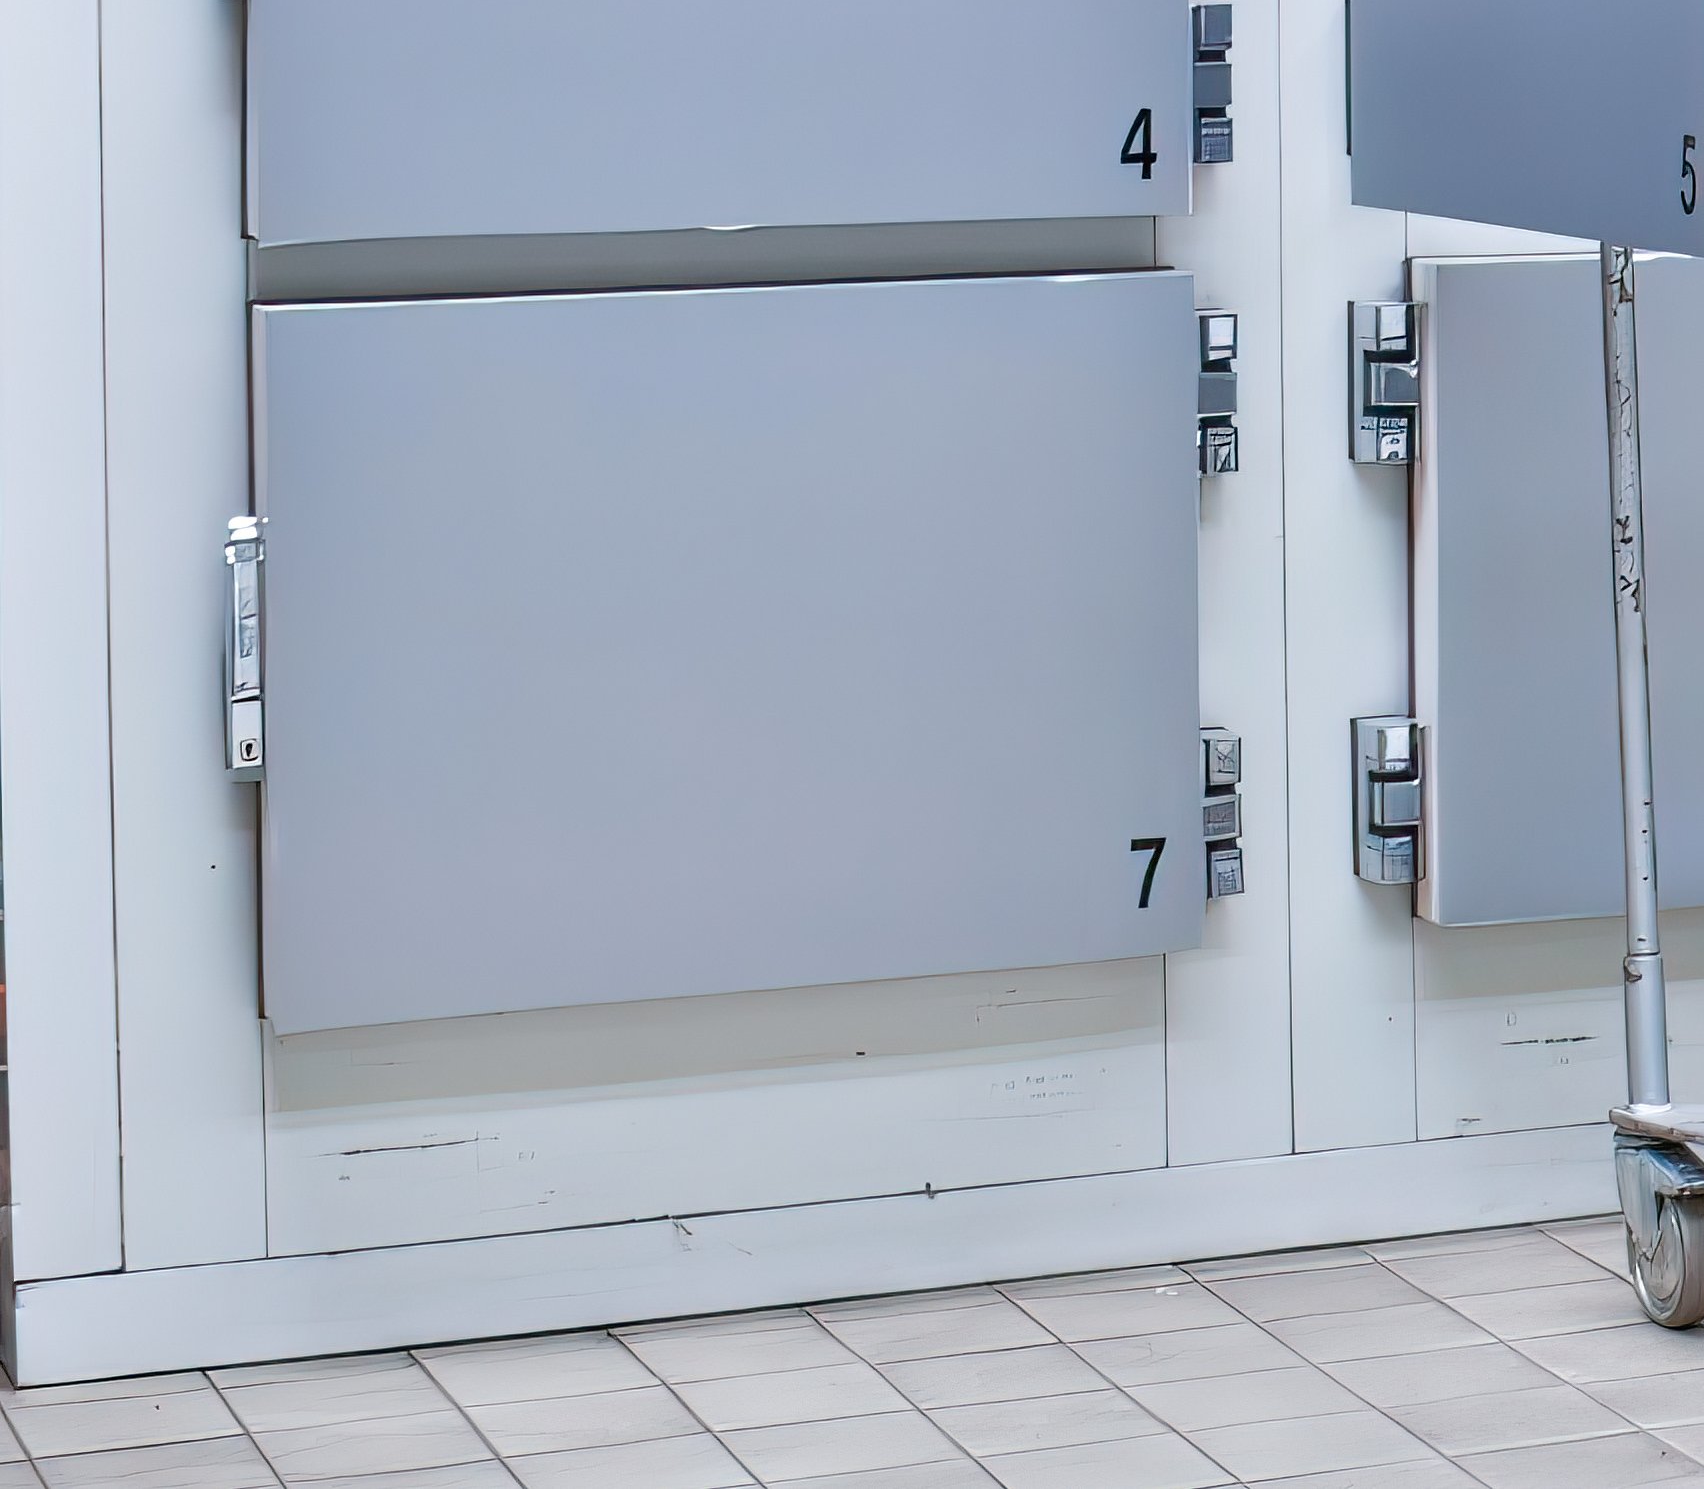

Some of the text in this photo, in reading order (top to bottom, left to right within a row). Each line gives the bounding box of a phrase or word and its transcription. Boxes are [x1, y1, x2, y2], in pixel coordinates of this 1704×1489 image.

[1120, 107, 1159, 180] 4
[1680, 134, 1697, 216] 5
[1130, 837, 1168, 910] 7
